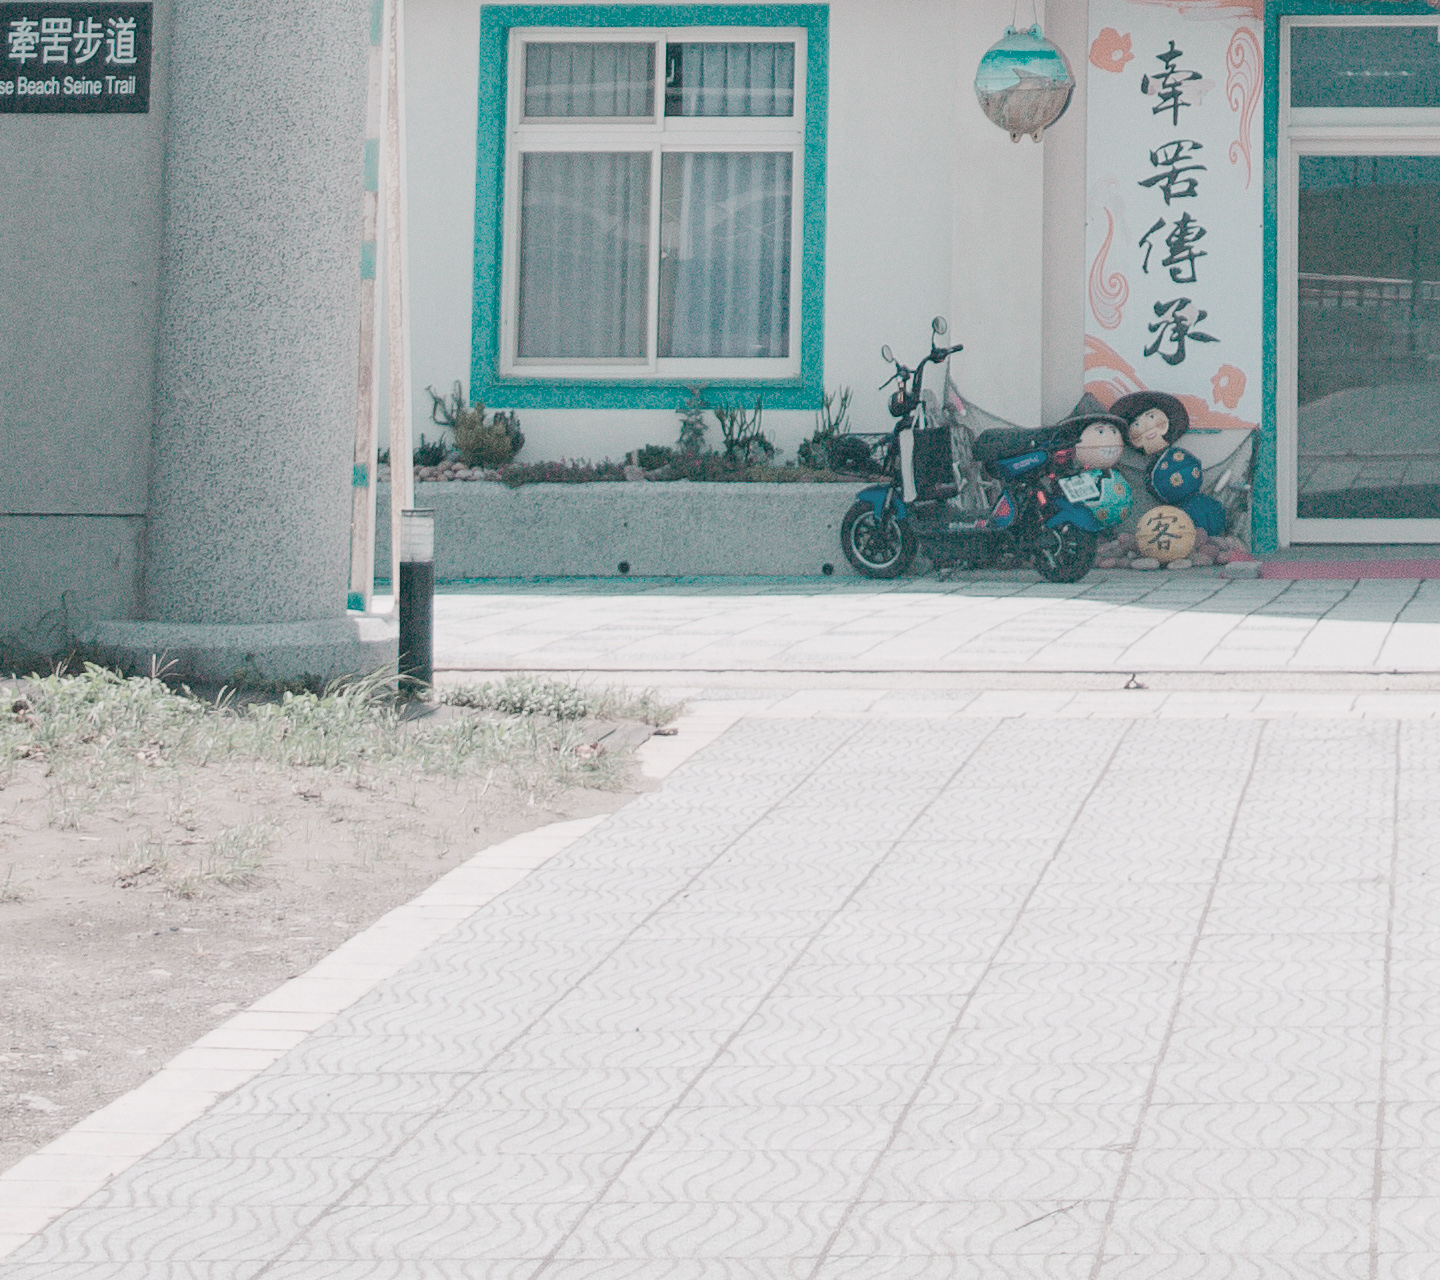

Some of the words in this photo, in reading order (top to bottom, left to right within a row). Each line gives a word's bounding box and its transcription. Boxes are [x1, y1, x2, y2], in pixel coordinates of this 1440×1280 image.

[8, 16, 137, 65] 牽罟步道
[17, 75, 60, 95] Beach
[63, 75, 102, 95] Seine
[105, 74, 136, 95] Trail
[1138, 40, 1221, 366] 牽罟傳承
[1146, 513, 1182, 550] 客
